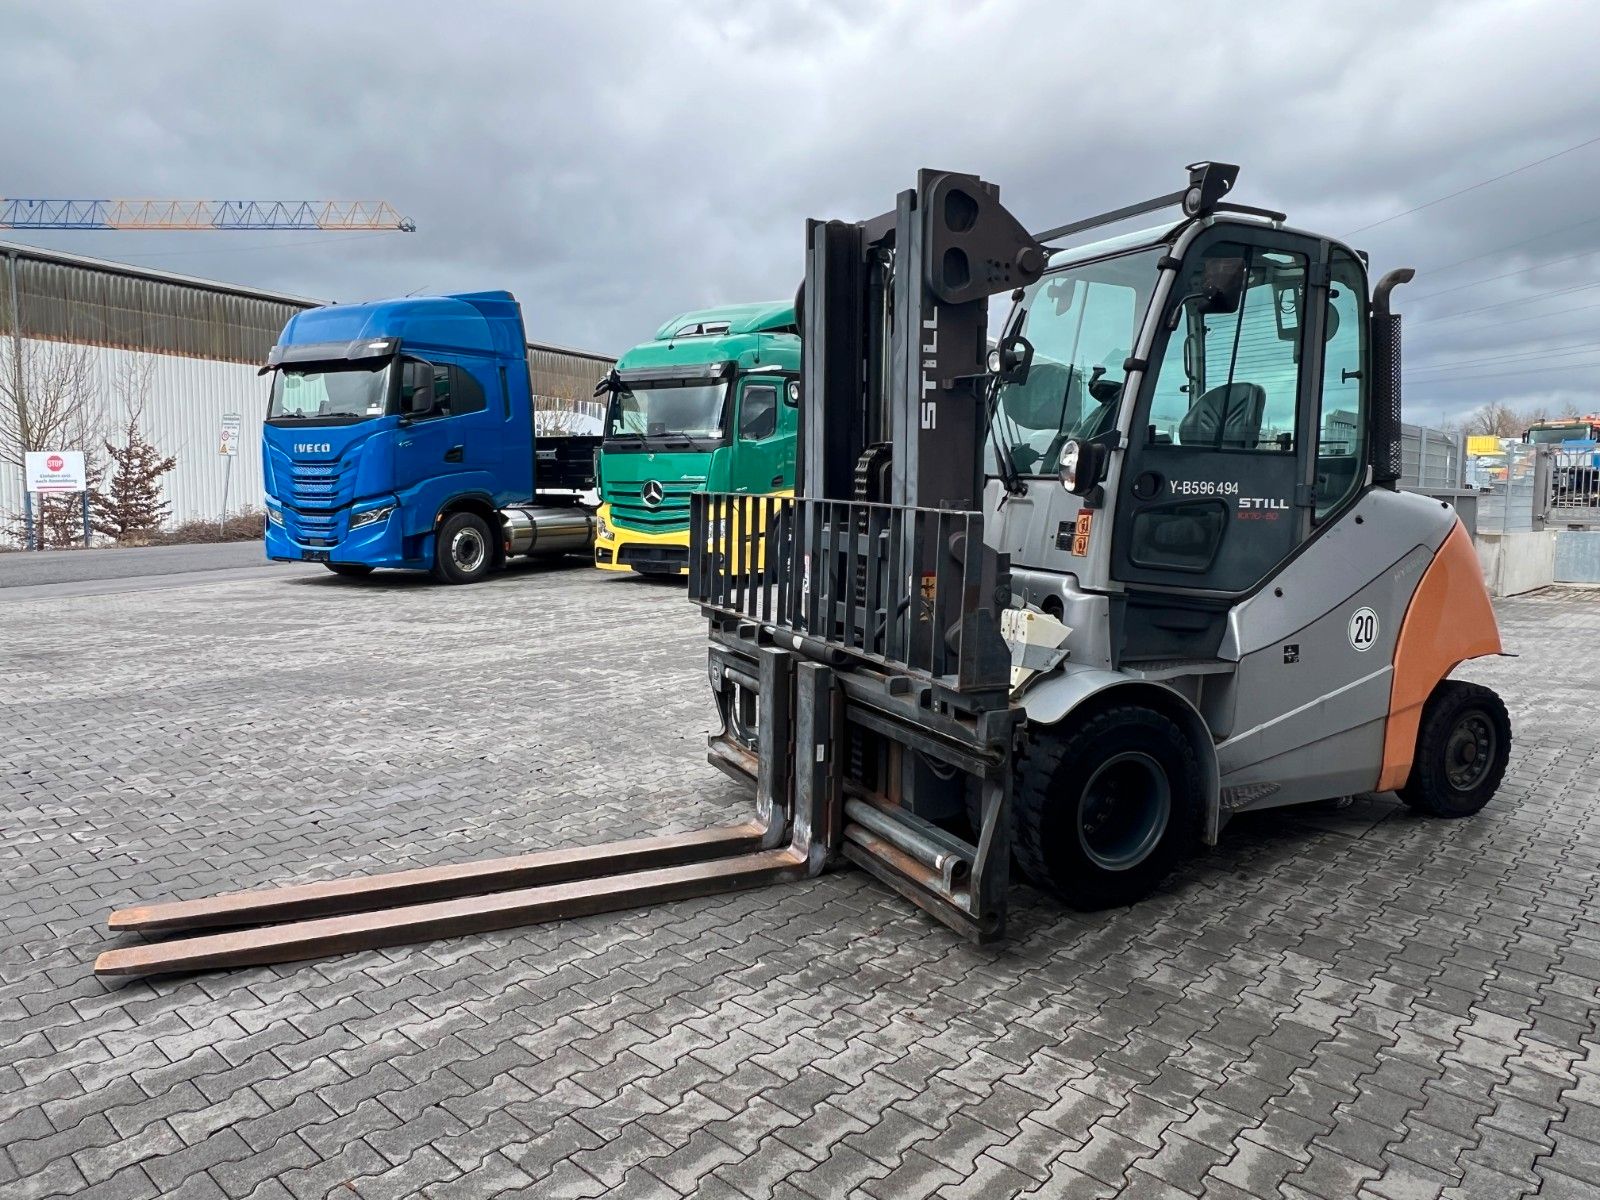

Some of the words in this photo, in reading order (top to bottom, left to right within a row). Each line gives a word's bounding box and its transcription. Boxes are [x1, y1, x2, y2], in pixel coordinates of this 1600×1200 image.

[920, 306, 938, 430] STILL
[293, 443, 331, 454] IVECO
[48, 459, 62, 468] STOP
[1238, 498, 1289, 509] STILL
[1354, 616, 1374, 643] 20
